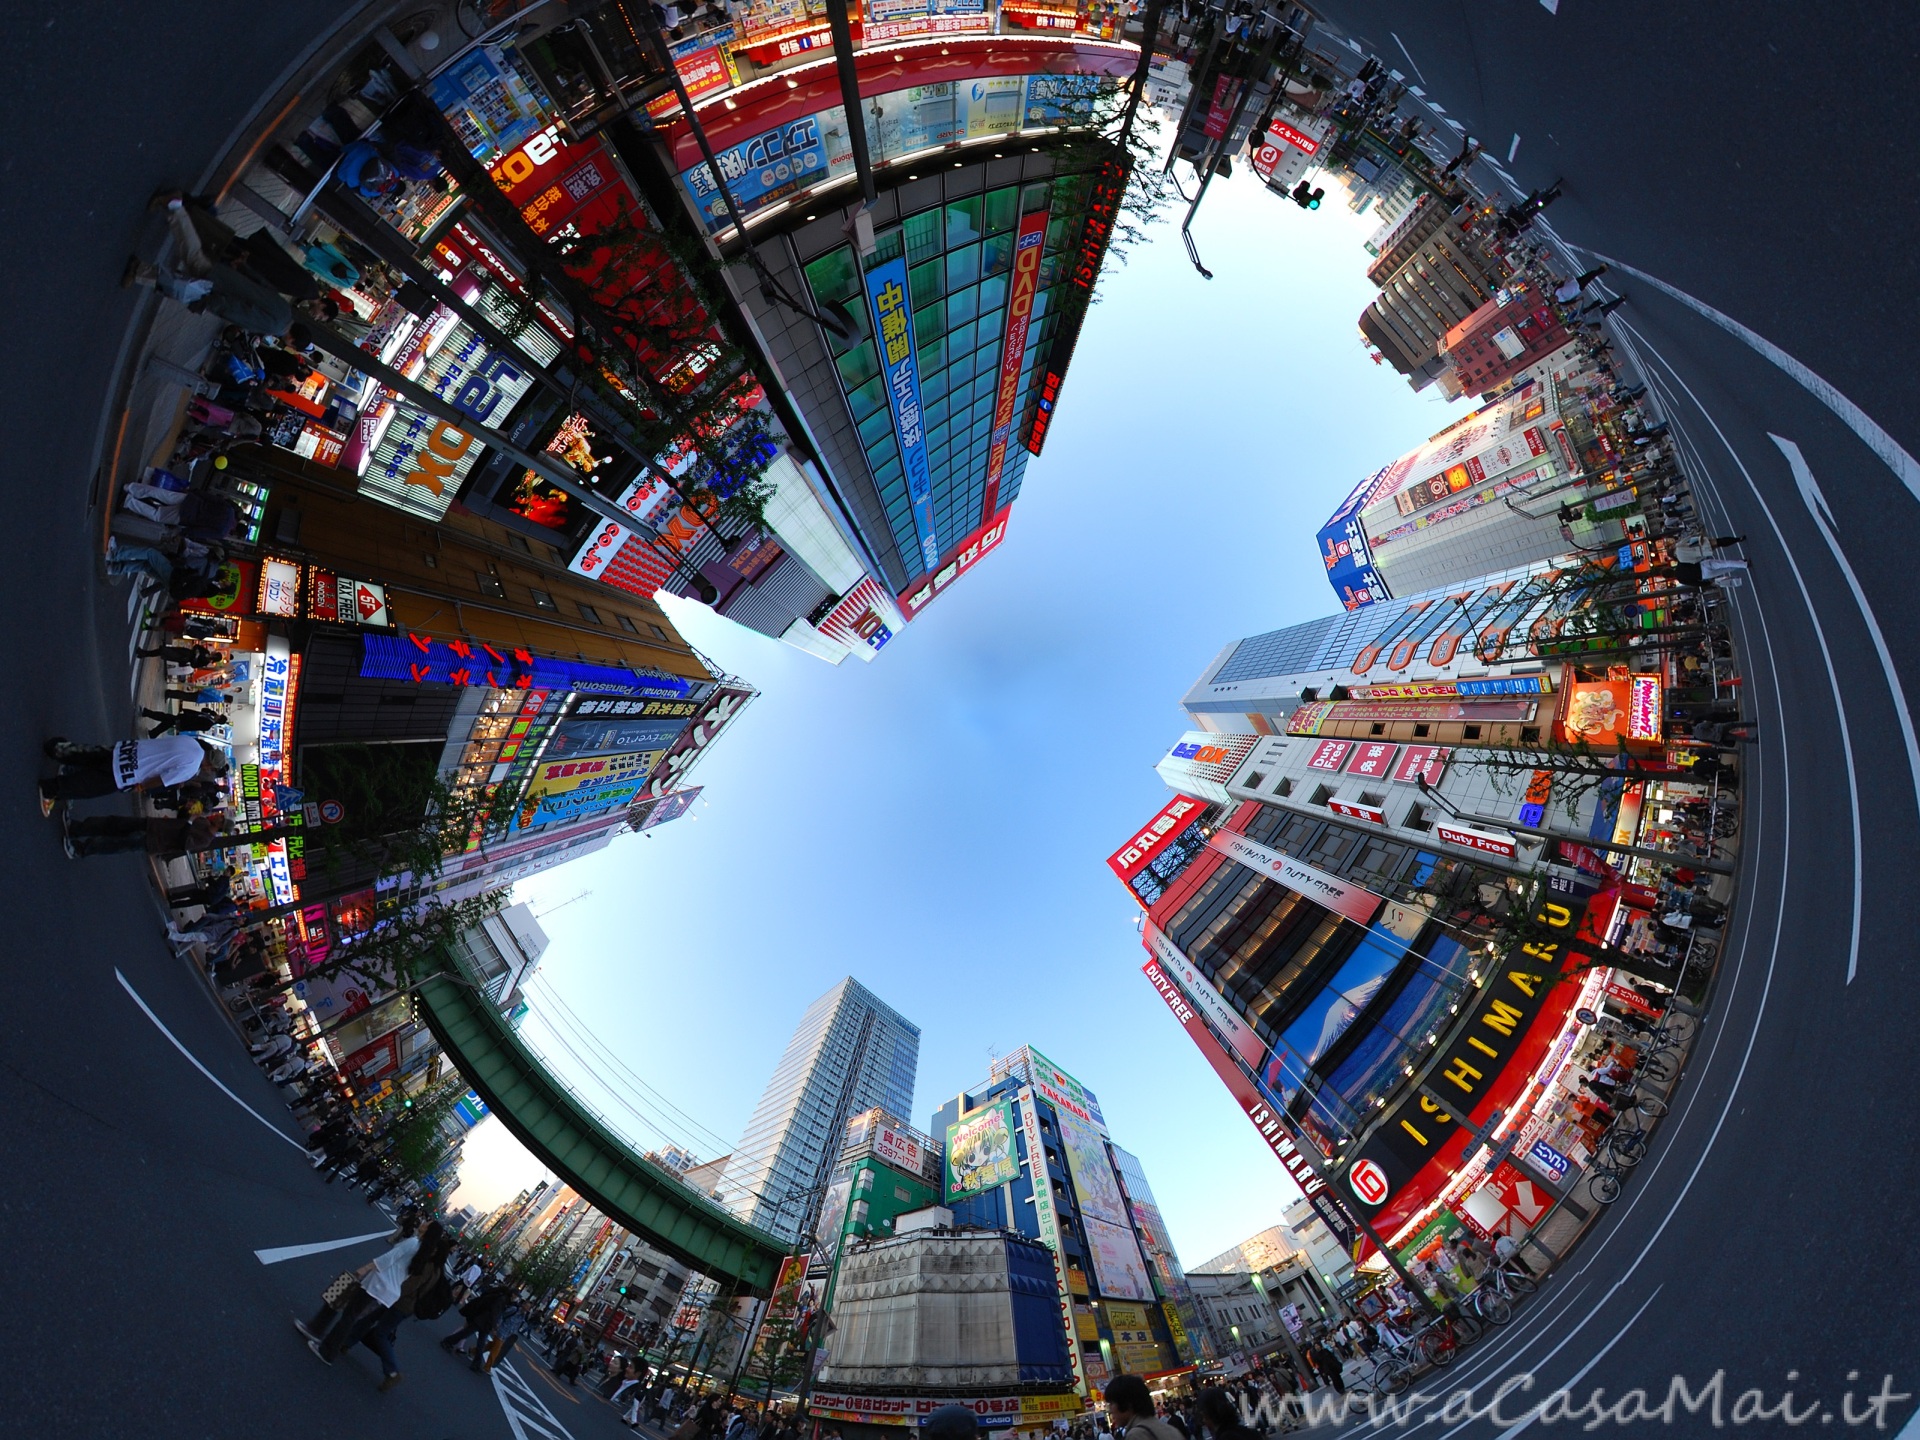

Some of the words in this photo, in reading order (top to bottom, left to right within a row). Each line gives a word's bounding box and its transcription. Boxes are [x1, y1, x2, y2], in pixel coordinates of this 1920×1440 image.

[778, 31, 834, 55] 電気1号店
[937, 129, 965, 139] SHARP
[830, 152, 853, 167] ational
[1262, 147, 1276, 161] P
[564, 173, 580, 187] Free
[567, 168, 603, 200] 免税
[578, 163, 594, 177] Duty
[687, 168, 710, 199] フェア
[519, 185, 563, 225] 総合家
[477, 244, 517, 284] Duty
[1009, 245, 1040, 318] DVD
[415, 310, 441, 340] Home
[392, 337, 420, 372] Electro
[456, 331, 485, 364] ome
[406, 363, 464, 440] Electnics
[874, 281, 928, 498] エアコン快感フェア開催中
[996, 367, 1020, 428] デジカメ
[362, 420, 370, 440] Free
[1527, 437, 1537, 450] Slot
[1529, 427, 1546, 454] Pachinko
[384, 439, 414, 480] Store
[1467, 459, 1481, 482] Pachinko
[1474, 463, 1483, 474] Slot
[1339, 519, 1372, 568] 武富士
[1617, 544, 1634, 569] SEGA
[740, 539, 776, 577] 総合家電
[908, 521, 1005, 611] 石丸電気
[267, 578, 282, 602] パソコン
[280, 580, 293, 615] オノデン
[314, 580, 329, 608] ONODEN
[337, 579, 353, 596] TAX
[339, 596, 354, 620] FREE
[359, 595, 377, 611] 5F
[408, 633, 534, 665] オノデン
[1395, 646, 1410, 664] SEGA
[263, 655, 288, 713] 冷蔵庫
[632, 668, 680, 682] National
[525, 694, 543, 711] 4F
[571, 680, 680, 699] National/Panasonic
[1632, 688, 1641, 707] GAME
[259, 718, 283, 766] 洗濯機
[616, 734, 659, 747] Everio
[652, 695, 741, 799] オノデン
[1313, 741, 1337, 768] Duty
[1325, 743, 1346, 769] Free
[1359, 744, 1385, 773] 免税
[1404, 762, 1420, 780] LIBRE
[1413, 754, 1423, 762] DE
[1422, 749, 1440, 780] PUESTOS
[241, 764, 259, 798] ONODEN
[1115, 796, 1195, 870] 石丸電気
[1441, 830, 1473, 845] Duty
[1476, 839, 1511, 854] Free
[270, 855, 290, 906] エアコン
[1284, 865, 1311, 883] DUTY
[1311, 878, 1345, 901] FREE
[1558, 879, 1569, 892] FREE
[1145, 964, 1172, 994] DUTY
[1163, 990, 1194, 1024] FREE
[1608, 983, 1620, 995] B1
[1620, 989, 1645, 1005] パソコン
[1193, 981, 1216, 1007] DUTY
[1214, 1007, 1240, 1034] FREE
[1399, 901, 1573, 1148] ISHIMARU
[1040, 1084, 1090, 1122] TAKARADA
[952, 1111, 1004, 1145] Welcome!
[1024, 1111, 1038, 1142] DUTY
[877, 1142, 919, 1171] 3397-1777
[882, 1130, 917, 1158] 貸広告
[1533, 1141, 1570, 1173] パソコン
[964, 1156, 1013, 1190] 秋葉原
[1029, 1145, 1044, 1179] FREE
[1550, 1170, 1560, 1181] B1
[951, 1183, 961, 1193] to
[1485, 1176, 1509, 1200] B1
[1314, 1193, 1349, 1233] 携帯電話
[1455, 1207, 1468, 1220] B1
[1465, 1217, 1492, 1244] パソコン
[1110, 1311, 1137, 1326] GAMERS
[1120, 1329, 1147, 1344] 本店
[985, 1416, 1011, 1424] CASIO
